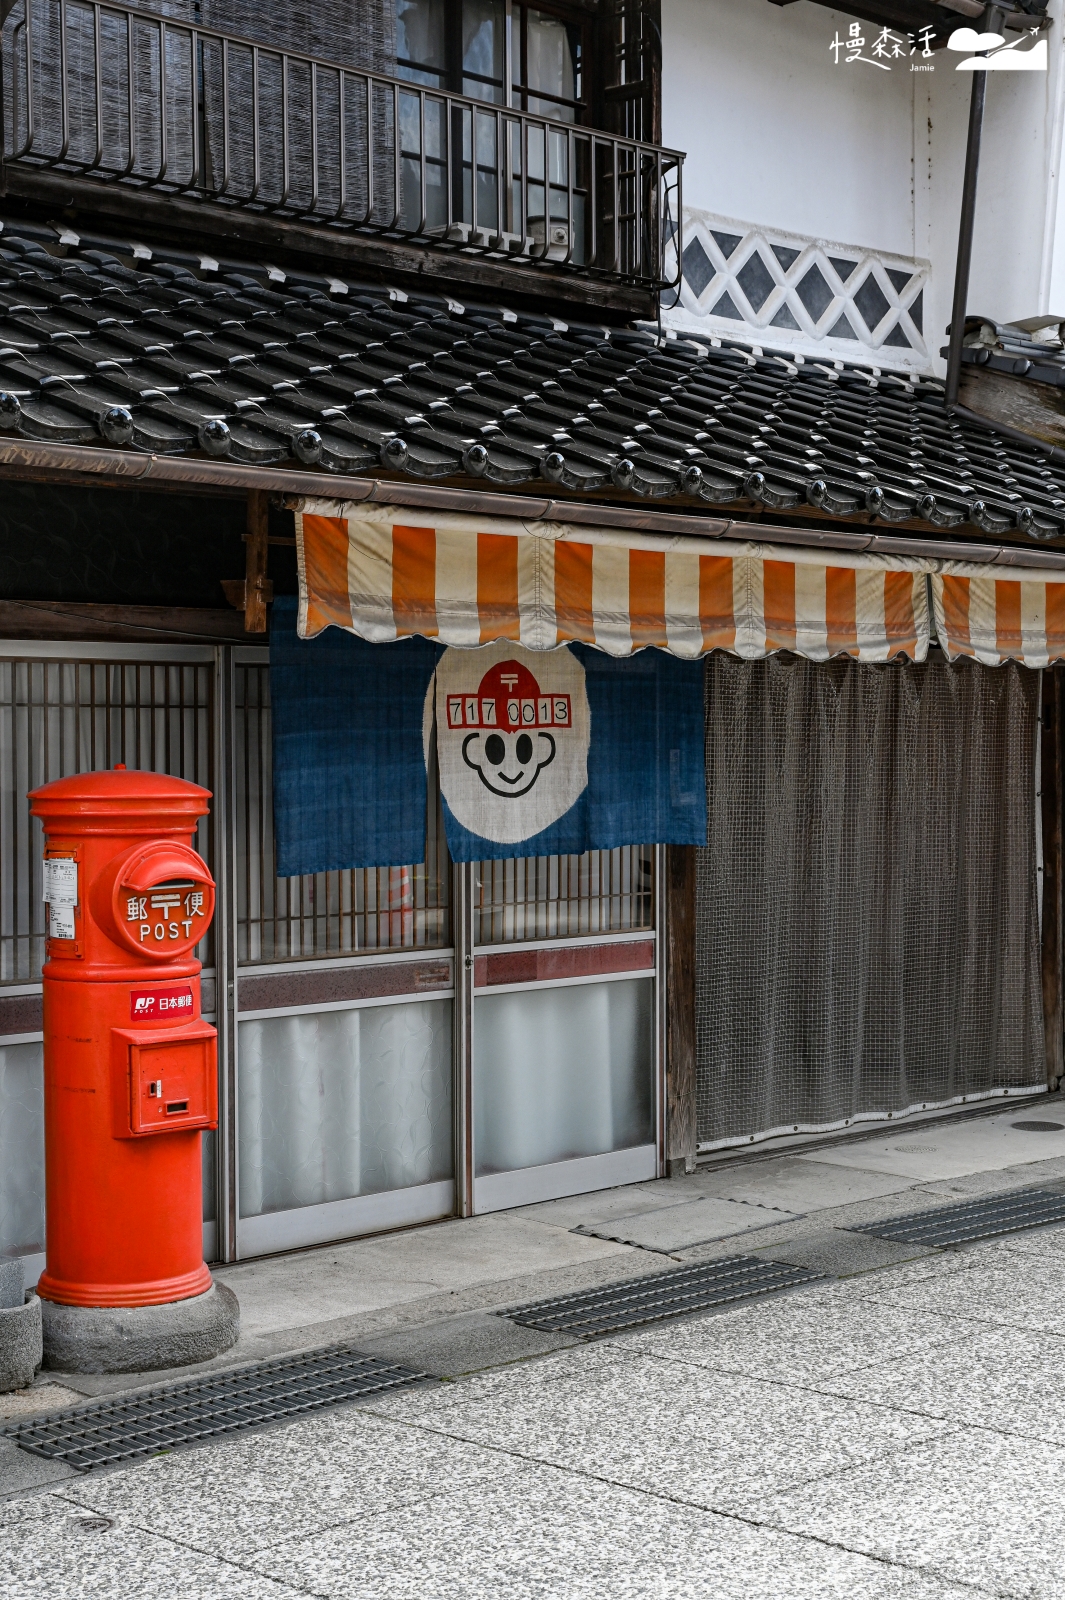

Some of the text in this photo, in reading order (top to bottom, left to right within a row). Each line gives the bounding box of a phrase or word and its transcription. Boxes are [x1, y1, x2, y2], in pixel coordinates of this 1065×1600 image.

[139, 920, 193, 942] POST
[159, 994, 193, 1011] 日本郵便
